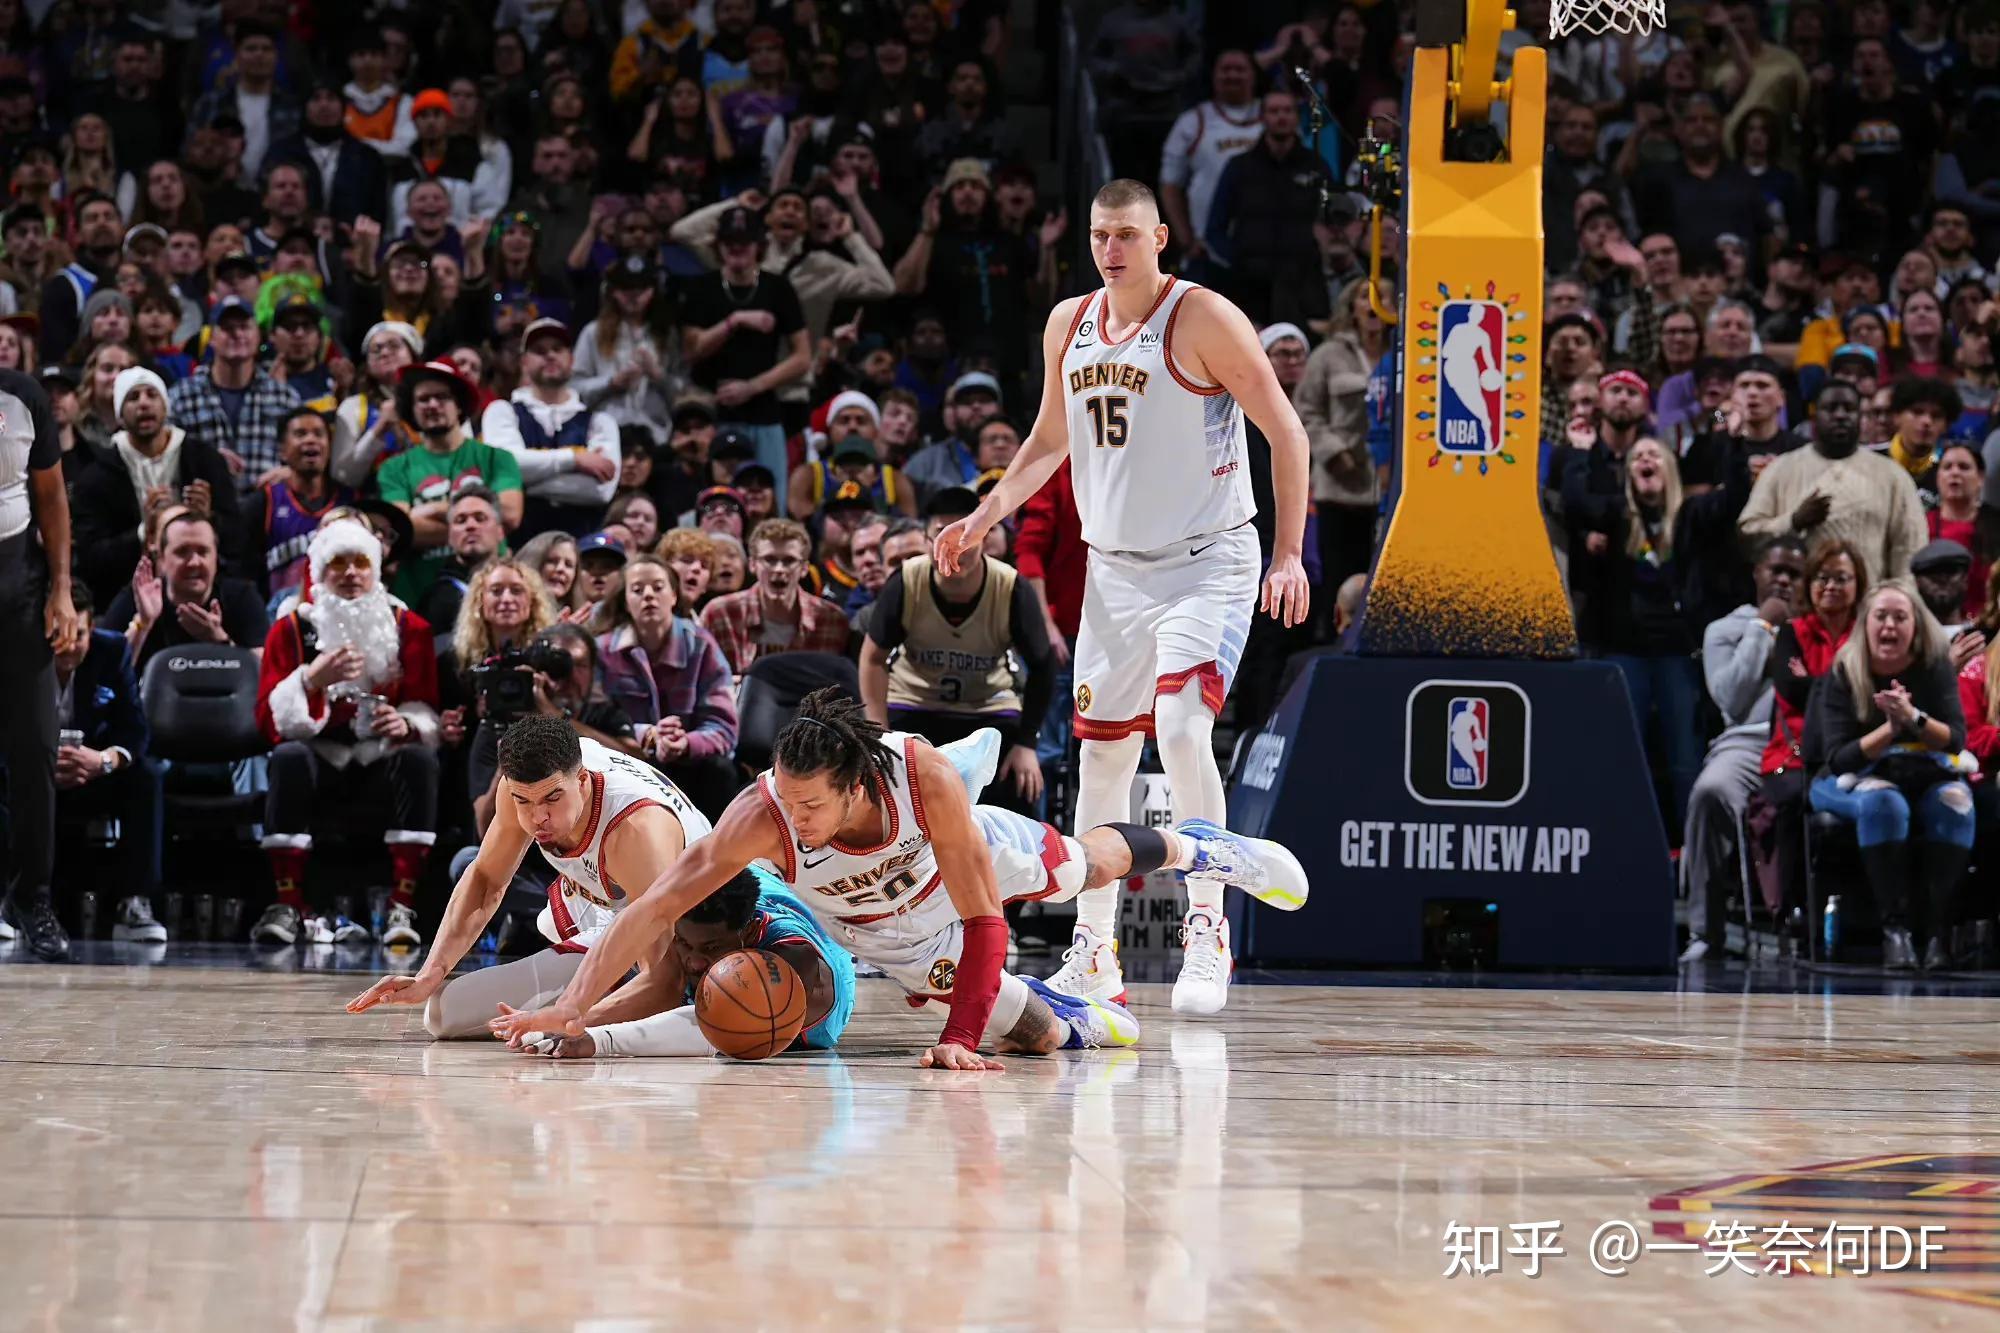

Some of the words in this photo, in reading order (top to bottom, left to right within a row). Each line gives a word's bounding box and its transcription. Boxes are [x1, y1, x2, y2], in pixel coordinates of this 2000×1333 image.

[1140, 333, 1159, 343] WU
[1069, 363, 1149, 395] DENVER
[1086, 396, 1128, 447] 15
[1446, 419, 1478, 444] NBA
[188, 659, 240, 669] LEXUS
[940, 677, 962, 702] 3
[1340, 820, 1395, 868] GET
[1401, 822, 1456, 870] THE
[1462, 824, 1528, 873] NEW
[1532, 826, 1590, 874] APP
[582, 857, 598, 875] WU
[811, 849, 921, 896] DENVER
[1121, 898, 1185, 921] FINAL
